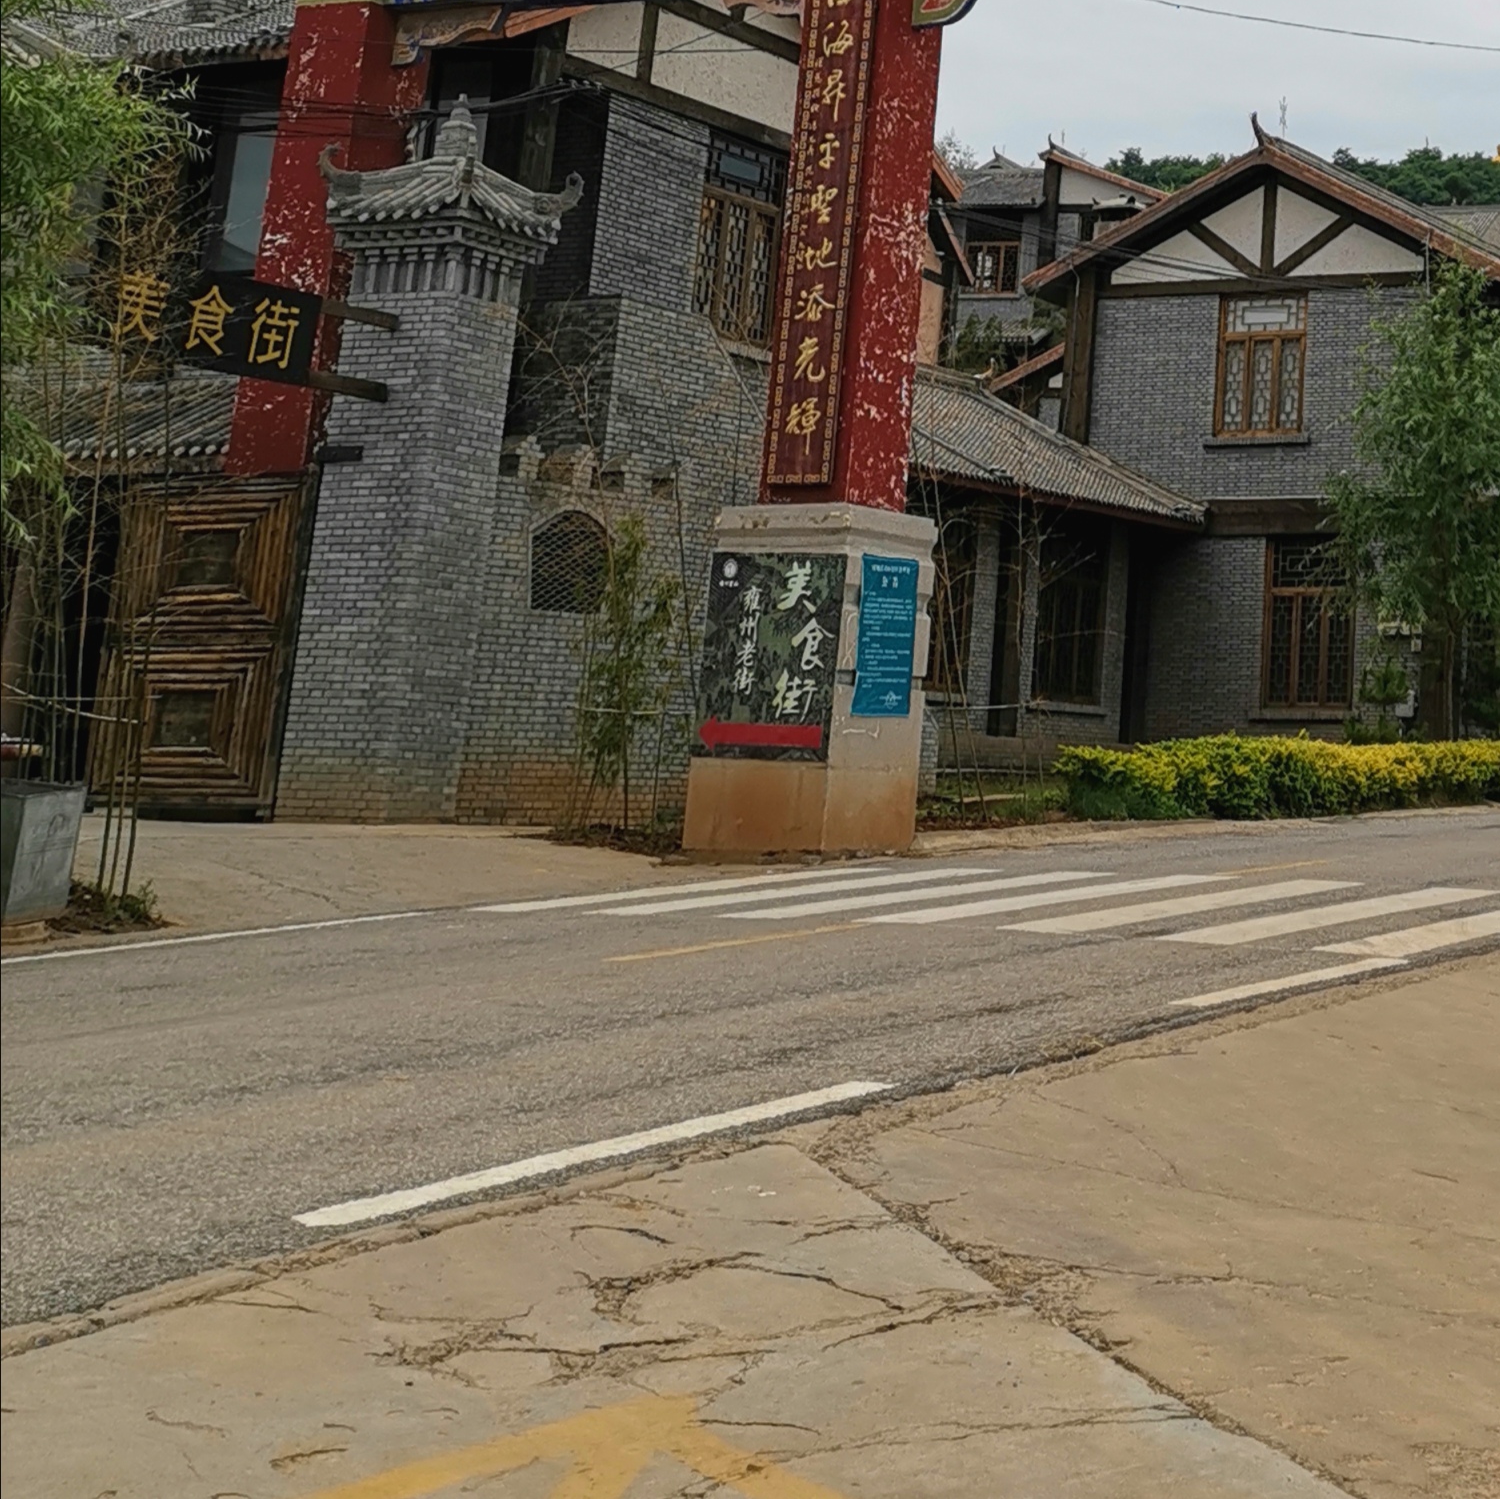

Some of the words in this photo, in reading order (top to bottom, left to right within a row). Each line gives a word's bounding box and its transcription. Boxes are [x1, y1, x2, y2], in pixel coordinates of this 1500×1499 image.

[119, 270, 301, 371] 美食街
[772, 559, 837, 723] 美食街
